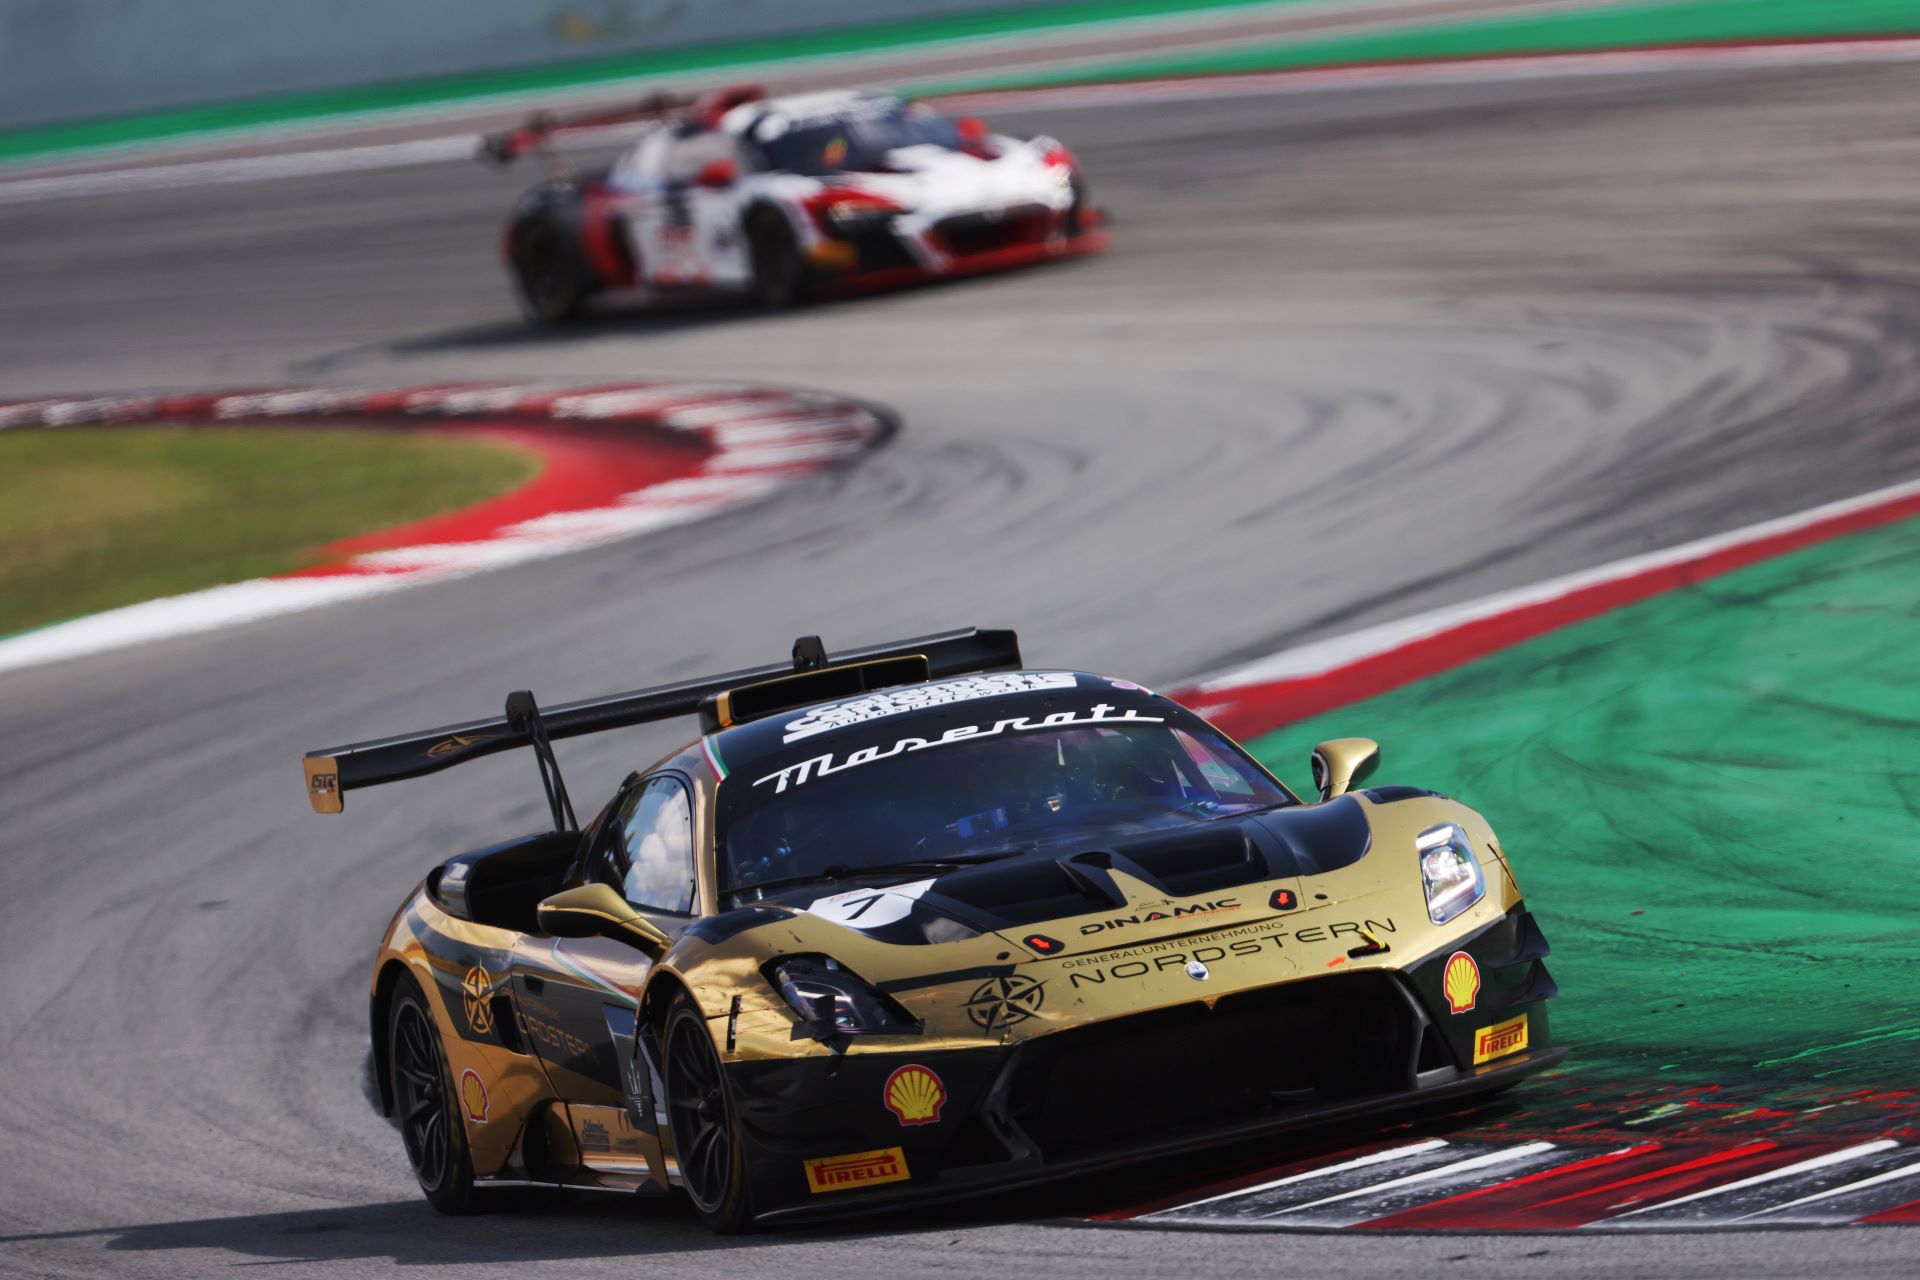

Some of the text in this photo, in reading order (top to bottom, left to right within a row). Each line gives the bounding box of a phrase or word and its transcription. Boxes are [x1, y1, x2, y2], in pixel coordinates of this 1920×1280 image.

[753, 703, 1165, 793] Maserati
[841, 893, 886, 921] 7
[1080, 898, 1241, 936] DINAMIC
[1062, 921, 1284, 969] GENERALUNTERNEHMUNG
[1069, 917, 1397, 989] NORDSTERN
[1479, 1022, 1524, 1056] PIRELLI
[813, 1155, 898, 1186] PIRELLI
